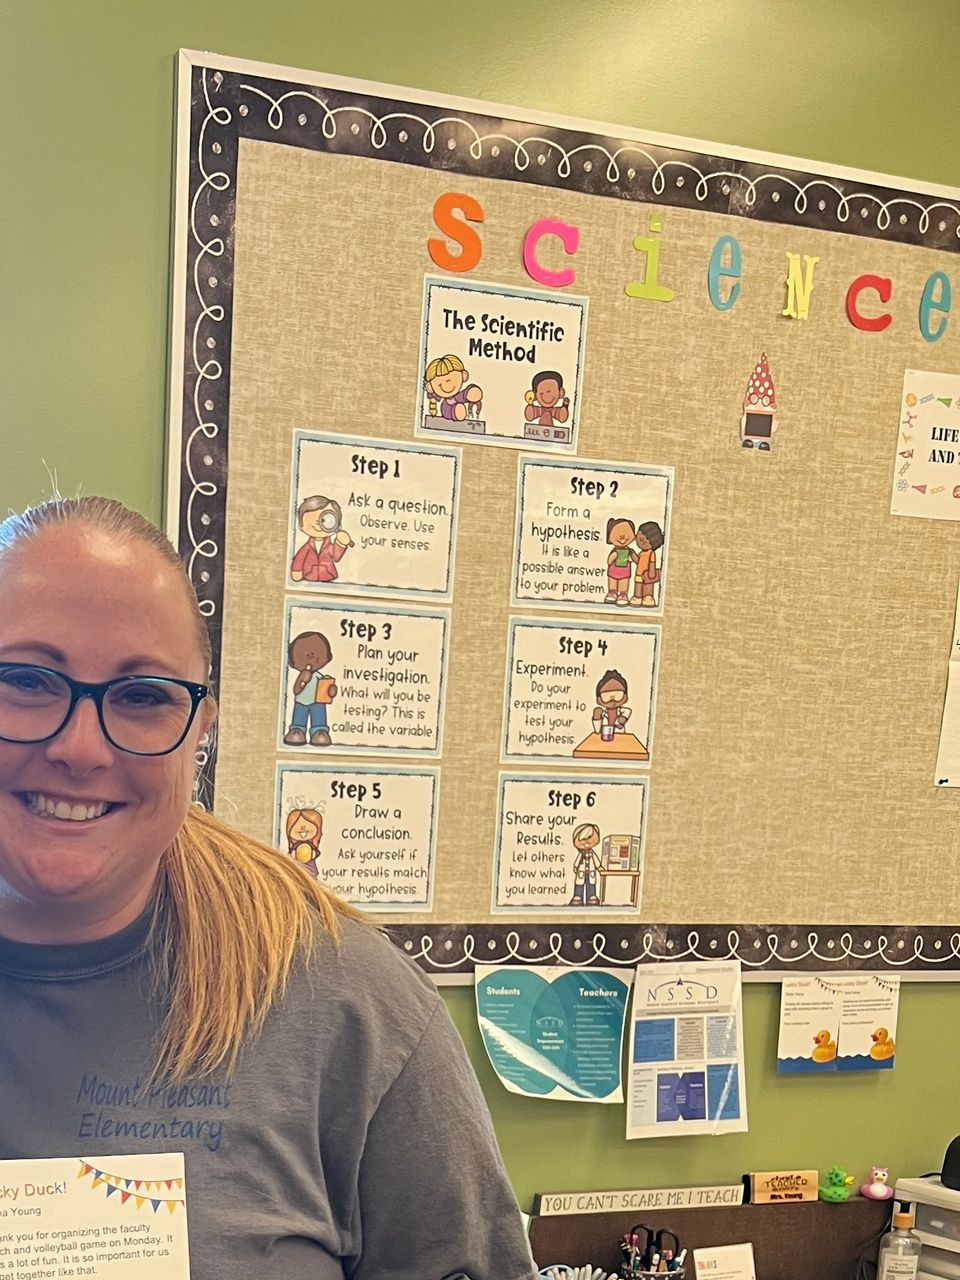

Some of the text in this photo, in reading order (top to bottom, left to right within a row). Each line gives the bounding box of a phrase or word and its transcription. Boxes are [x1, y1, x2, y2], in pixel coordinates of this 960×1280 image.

[443, 308, 564, 342] The Scientific
[469, 338, 535, 363] Method
[931, 427, 959, 442] LIFE
[928, 449, 954, 464] AND
[352, 454, 400, 479] Step 1
[571, 477, 618, 499] Step 2
[348, 492, 370, 507] Ask
[376, 499, 383, 509] a
[547, 502, 590, 519] Form a
[414, 521, 434, 533] Use
[361, 536, 387, 549] your
[542, 544, 589, 558] It is like a
[523, 561, 605, 577] possible answer
[520, 577, 530, 589] to
[534, 581, 558, 594] your
[340, 619, 392, 641] Step 3
[358, 644, 418, 665] Plan your
[559, 636, 608, 657] Step 4
[341, 686, 430, 704] What will you be
[531, 681, 571, 697] Do your
[344, 704, 425, 720] testing? This is
[514, 699, 586, 711] experiment to
[332, 722, 363, 733] called
[368, 723, 385, 734] the
[525, 715, 573, 730] test your
[331, 781, 381, 801] Step 5
[549, 790, 596, 810] Step 6
[355, 804, 401, 819] Draw a
[506, 811, 577, 830] Share your
[338, 849, 417, 863] Ask yourself if
[531, 852, 565, 863] others
[322, 867, 427, 880] your results match
[510, 867, 565, 879] know what
[506, 883, 566, 897] you learned
[486, 987, 520, 996] Students
[579, 988, 618, 997] Teachers
[76, 1073, 140, 1107] Mount
[79, 1111, 224, 1151] Elementary
[25, 1181, 67, 1197] Duck!
[545, 1189, 739, 1212] YOU CAN'T SCARE ME I TEACH
[10, 1207, 41, 1217] Young
[16, 1234, 34, 1243] you
[36, 1231, 48, 1240] for
[51, 1228, 99, 1240] organizing
[103, 1225, 117, 1235] the
[120, 1224, 150, 1234] faculty
[14, 1245, 31, 1255] and
[34, 1242, 78, 1254] volleyball
[80, 1242, 106, 1251] game
[167, 1234, 173, 1243] It
[8, 1260, 14, 1268] a
[17, 1258, 28, 1267] lot
[31, 1256, 40, 1266] of
[43, 1256, 60, 1265] fun.
[63, 1255, 69, 1263] It
[72, 1254, 80, 1263] is
[83, 1254, 94, 1262] so
[96, 1249, 140, 1262] important
[143, 1248, 154, 1258] for
[158, 1248, 169, 1257] us
[17, 1268, 55, 1280] together
[58, 1267, 74, 1277] like
